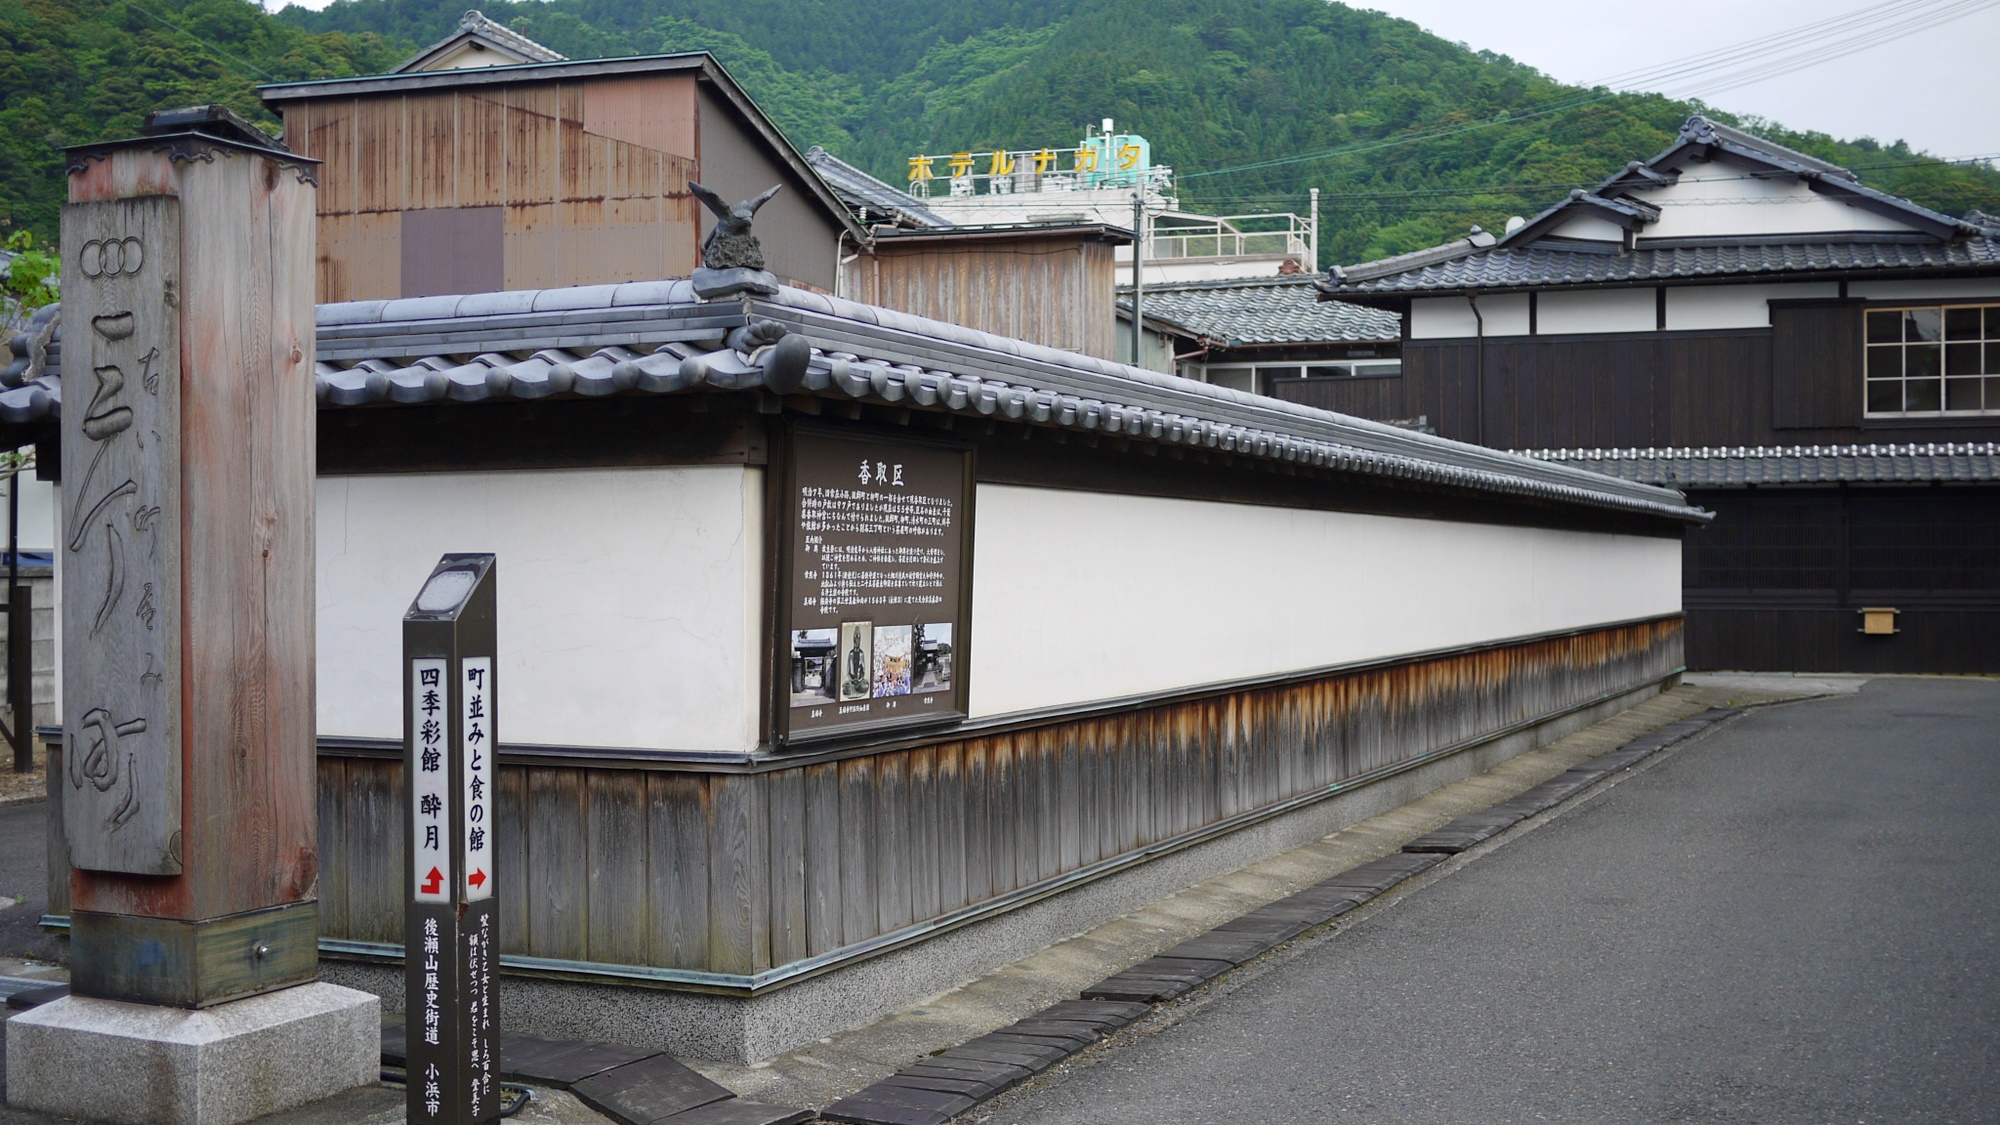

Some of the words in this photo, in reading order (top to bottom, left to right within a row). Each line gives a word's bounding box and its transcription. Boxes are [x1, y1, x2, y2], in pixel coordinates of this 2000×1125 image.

[908, 143, 1141, 181] ホテルナガタ
[858, 459, 904, 487] 香取区
[420, 668, 442, 773] 四季彩館
[468, 667, 485, 852] 町並みと食の館
[420, 793, 442, 851] 酔月
[424, 917, 440, 1045] 後瀬山歴史街道
[425, 1062, 441, 1117] 小浜市
[471, 1078, 480, 1117] 登美子
